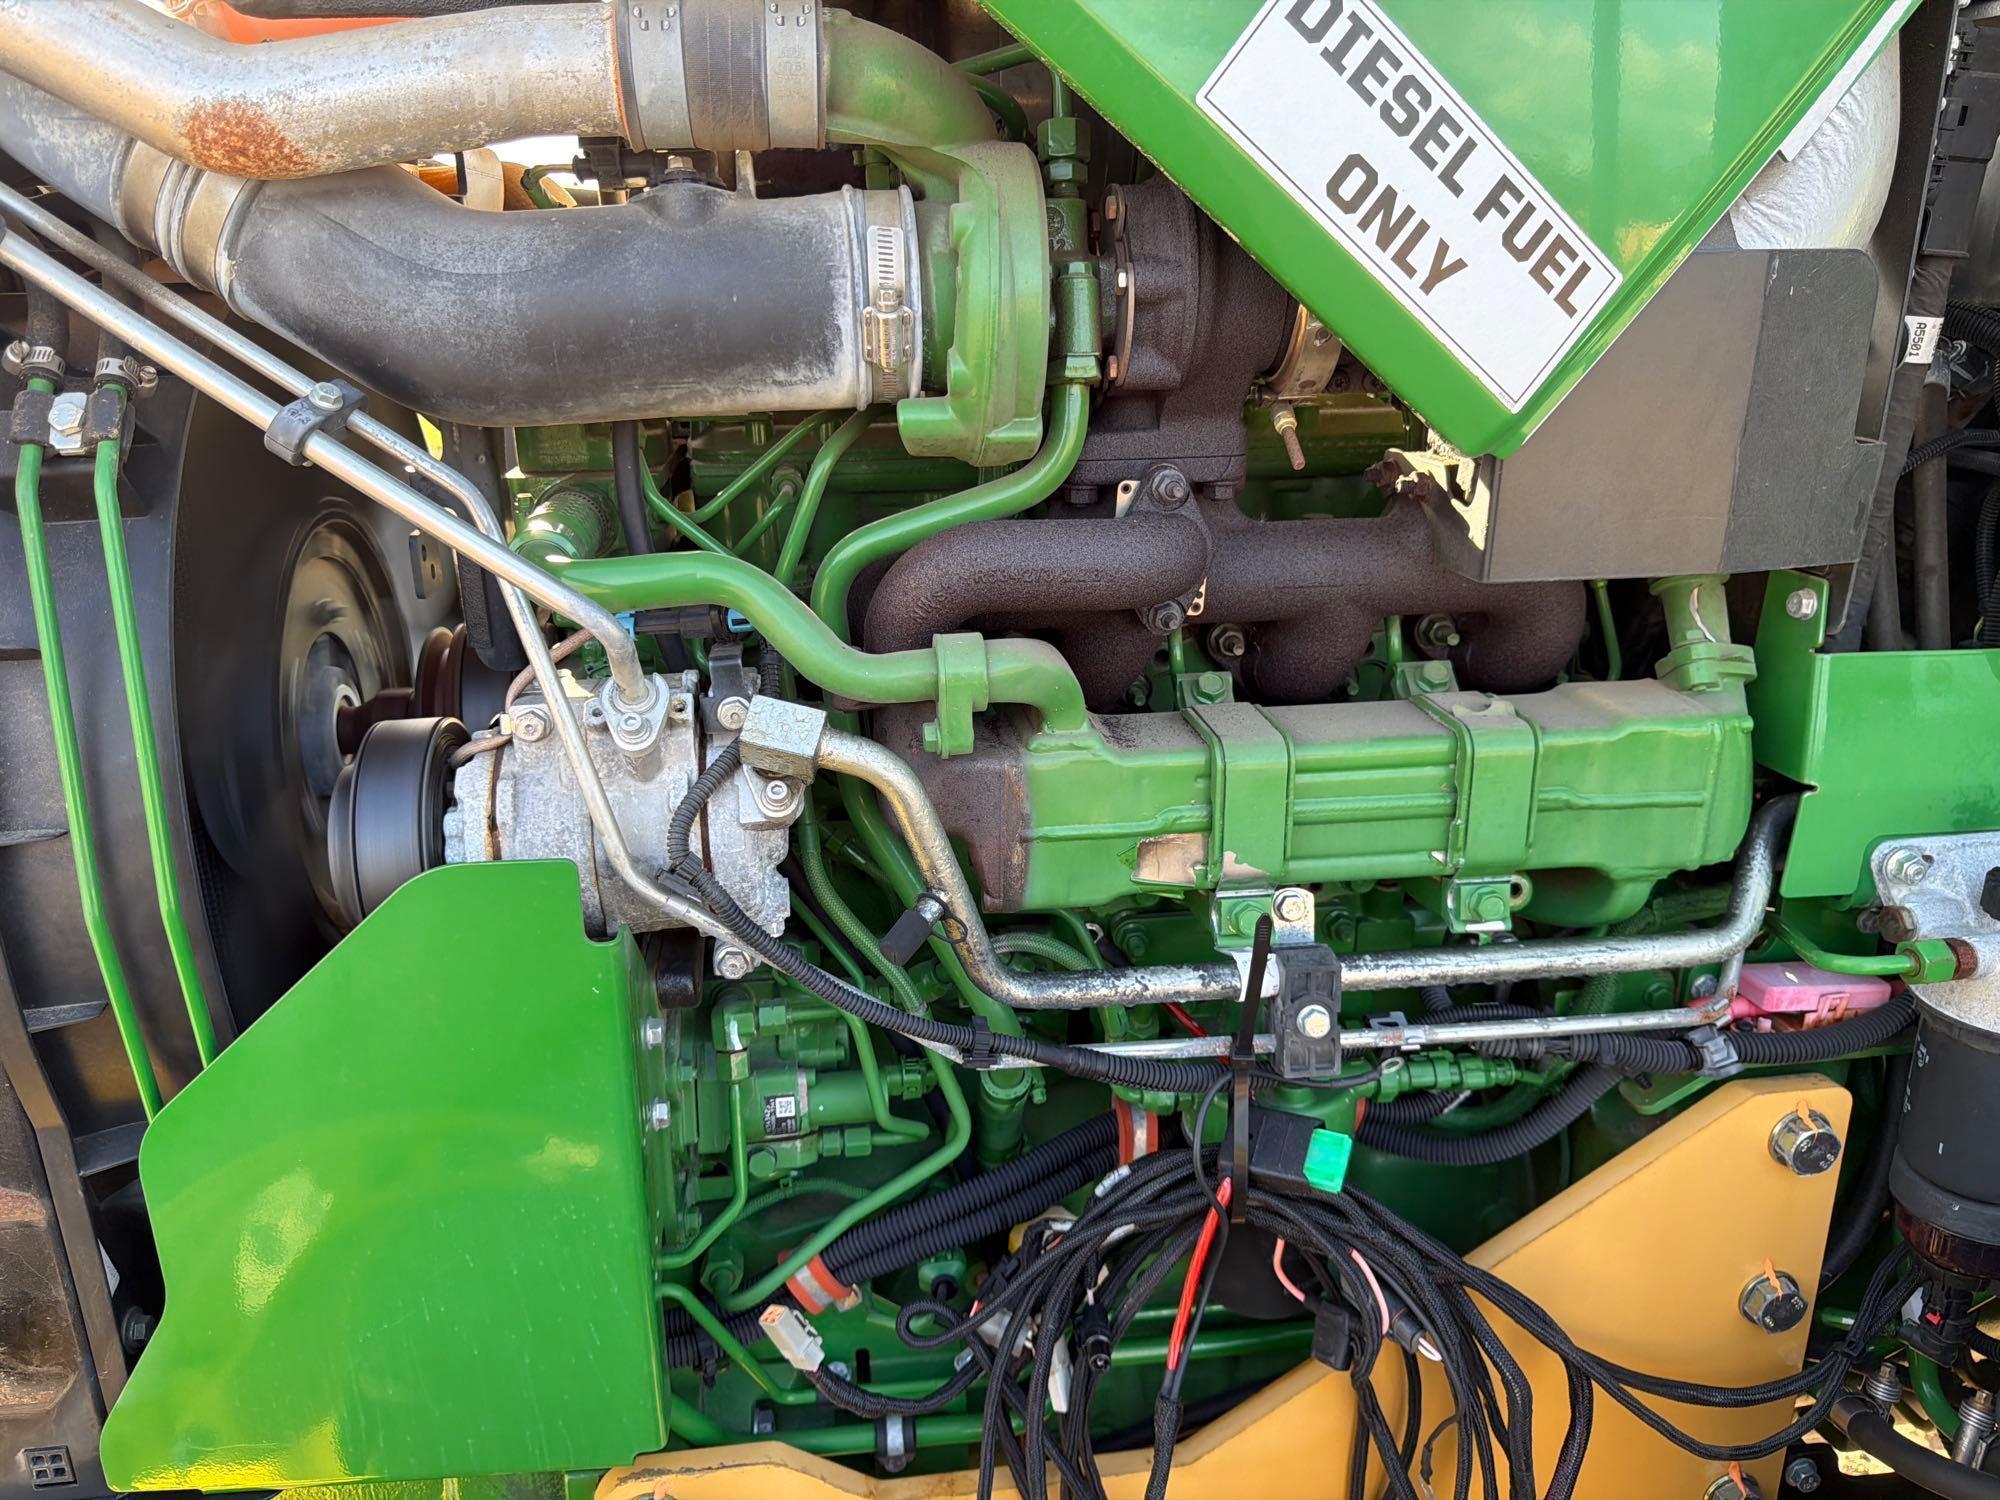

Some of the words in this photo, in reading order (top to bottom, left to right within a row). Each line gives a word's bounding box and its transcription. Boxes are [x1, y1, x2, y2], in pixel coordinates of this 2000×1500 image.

[1284, 0, 1478, 198] DIESEL
[1472, 174, 1592, 319] FUEL
[1326, 153, 1468, 296] ONLY
[1908, 322, 1927, 357] A5501
